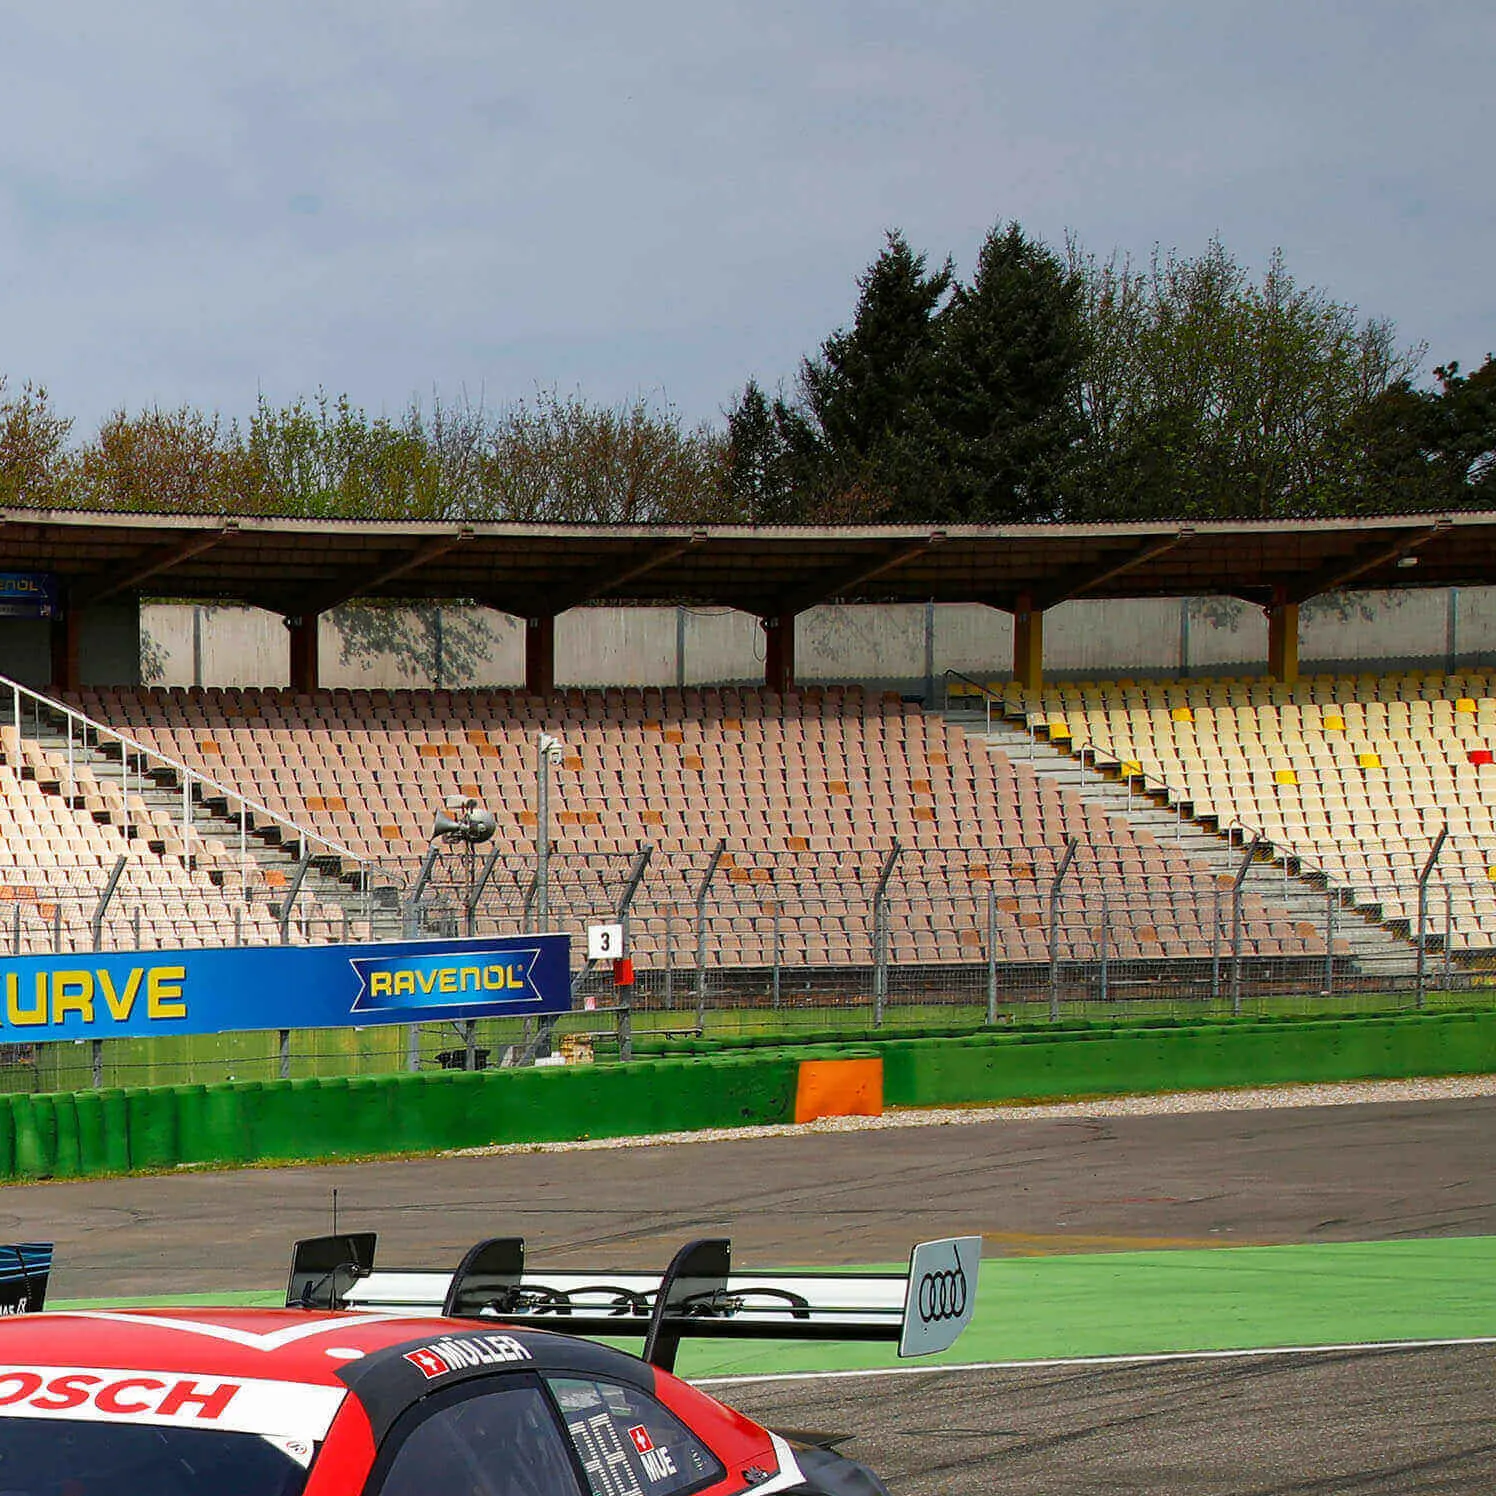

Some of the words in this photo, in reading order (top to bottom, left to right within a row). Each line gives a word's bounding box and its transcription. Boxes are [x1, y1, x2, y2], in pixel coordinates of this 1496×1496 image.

[600, 932, 611, 952] 3
[371, 963, 524, 997] RAVENOL
[639, 1445, 678, 1482] MUE
